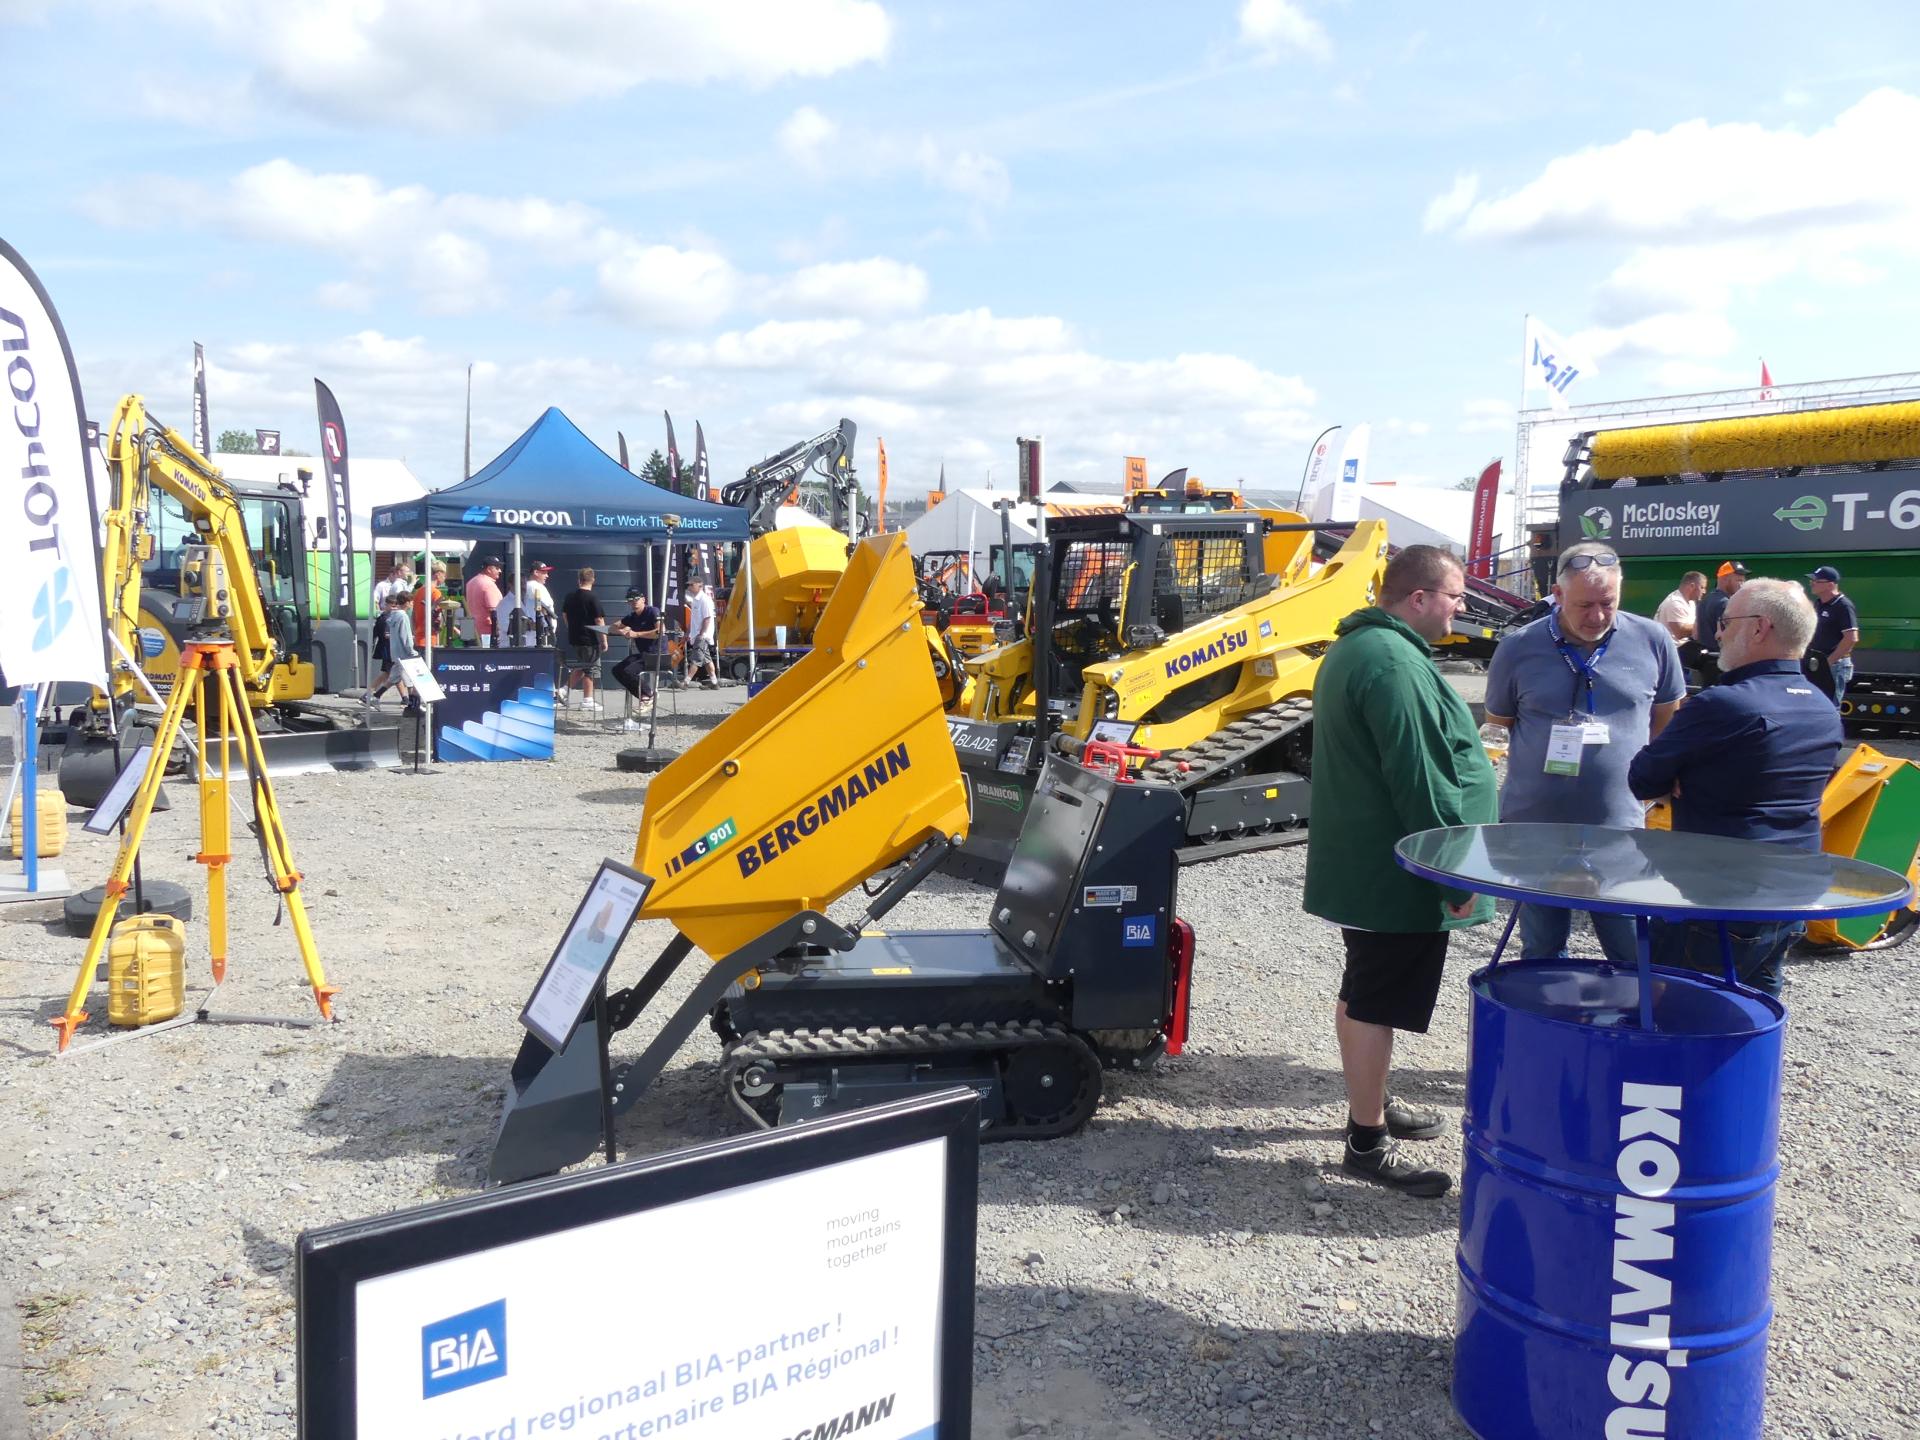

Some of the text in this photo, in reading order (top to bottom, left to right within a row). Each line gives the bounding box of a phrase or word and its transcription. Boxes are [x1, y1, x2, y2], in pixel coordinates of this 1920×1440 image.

[174, 469, 206, 502] KOMATSU
[492, 509, 573, 526] TOPCON
[596, 514, 615, 526] For
[617, 515, 648, 527] Work
[649, 516, 674, 528] Th
[1623, 501, 1720, 523] McCloskey
[1622, 521, 1719, 539] Environmental
[1165, 629, 1248, 679] KOMATSU
[955, 734, 998, 752] BLADE
[977, 783, 1019, 801] DRANICON
[736, 742, 912, 879] BERGMANN
[709, 823, 734, 846] 901
[826, 1208, 880, 1231] moving
[826, 1220, 902, 1250] mountains
[826, 1241, 888, 1269] together
[1604, 1081, 1689, 1440] KOMATSU
[527, 1371, 666, 1435] regionaal
[674, 1321, 830, 1387] BIA-partner
[733, 1373, 779, 1406] BIA
[786, 1330, 887, 1387] Régional
